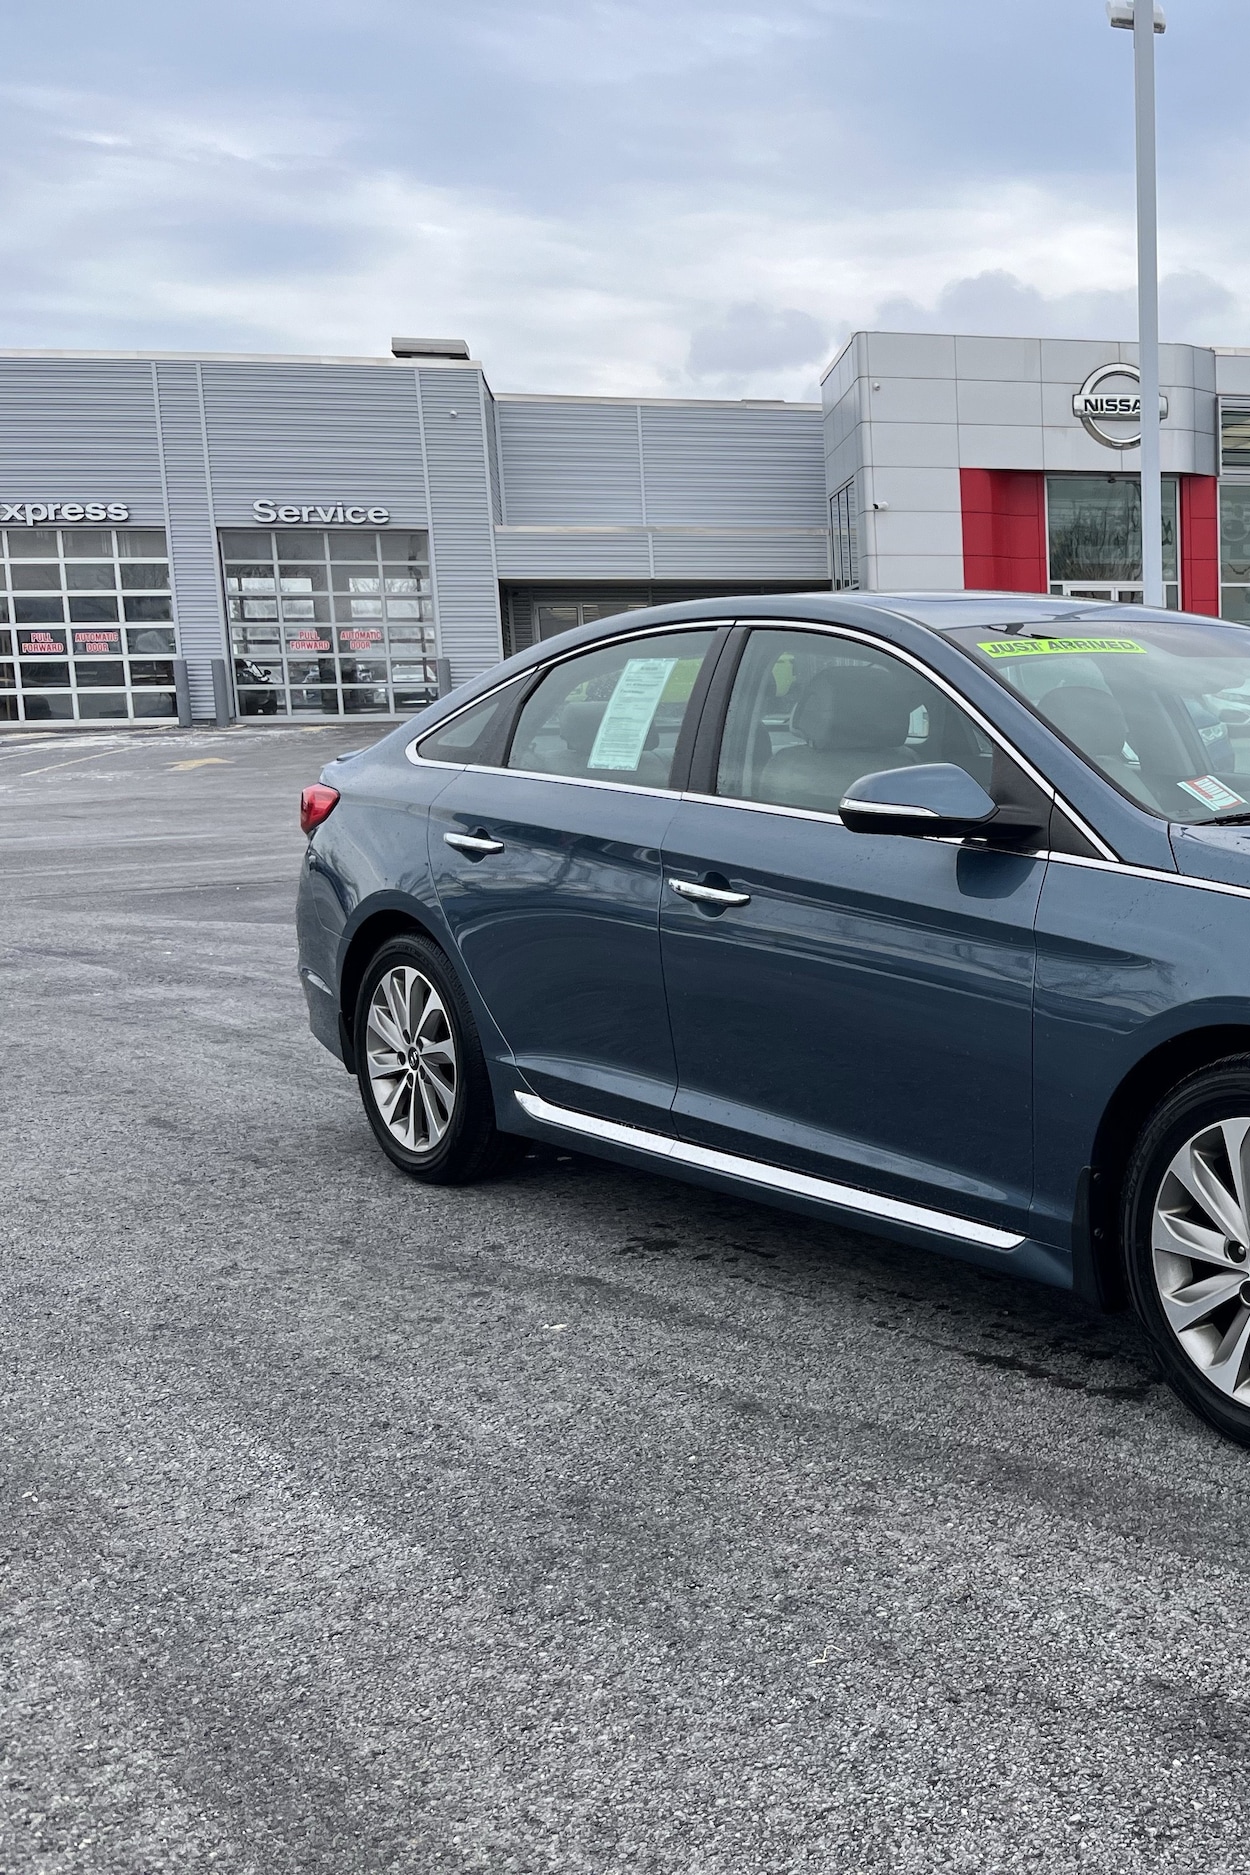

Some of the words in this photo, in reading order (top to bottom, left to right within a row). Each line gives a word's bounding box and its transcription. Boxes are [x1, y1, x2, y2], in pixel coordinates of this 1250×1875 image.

[1084, 399, 1140, 412] NISSA
[0, 503, 129, 526] xpress
[253, 499, 390, 524] Service
[31, 633, 53, 642] PULL
[75, 632, 119, 642] AUTOMATIC
[299, 631, 320, 640] PULL
[340, 630, 382, 640] AUTOMATIC
[22, 643, 64, 653] FORWARD
[86, 643, 109, 653] DOOR
[290, 641, 330, 650] FORWARD
[350, 641, 371, 650] DOOR
[988, 641, 1042, 654] JUST
[1048, 640, 1139, 651] ARRIVED
